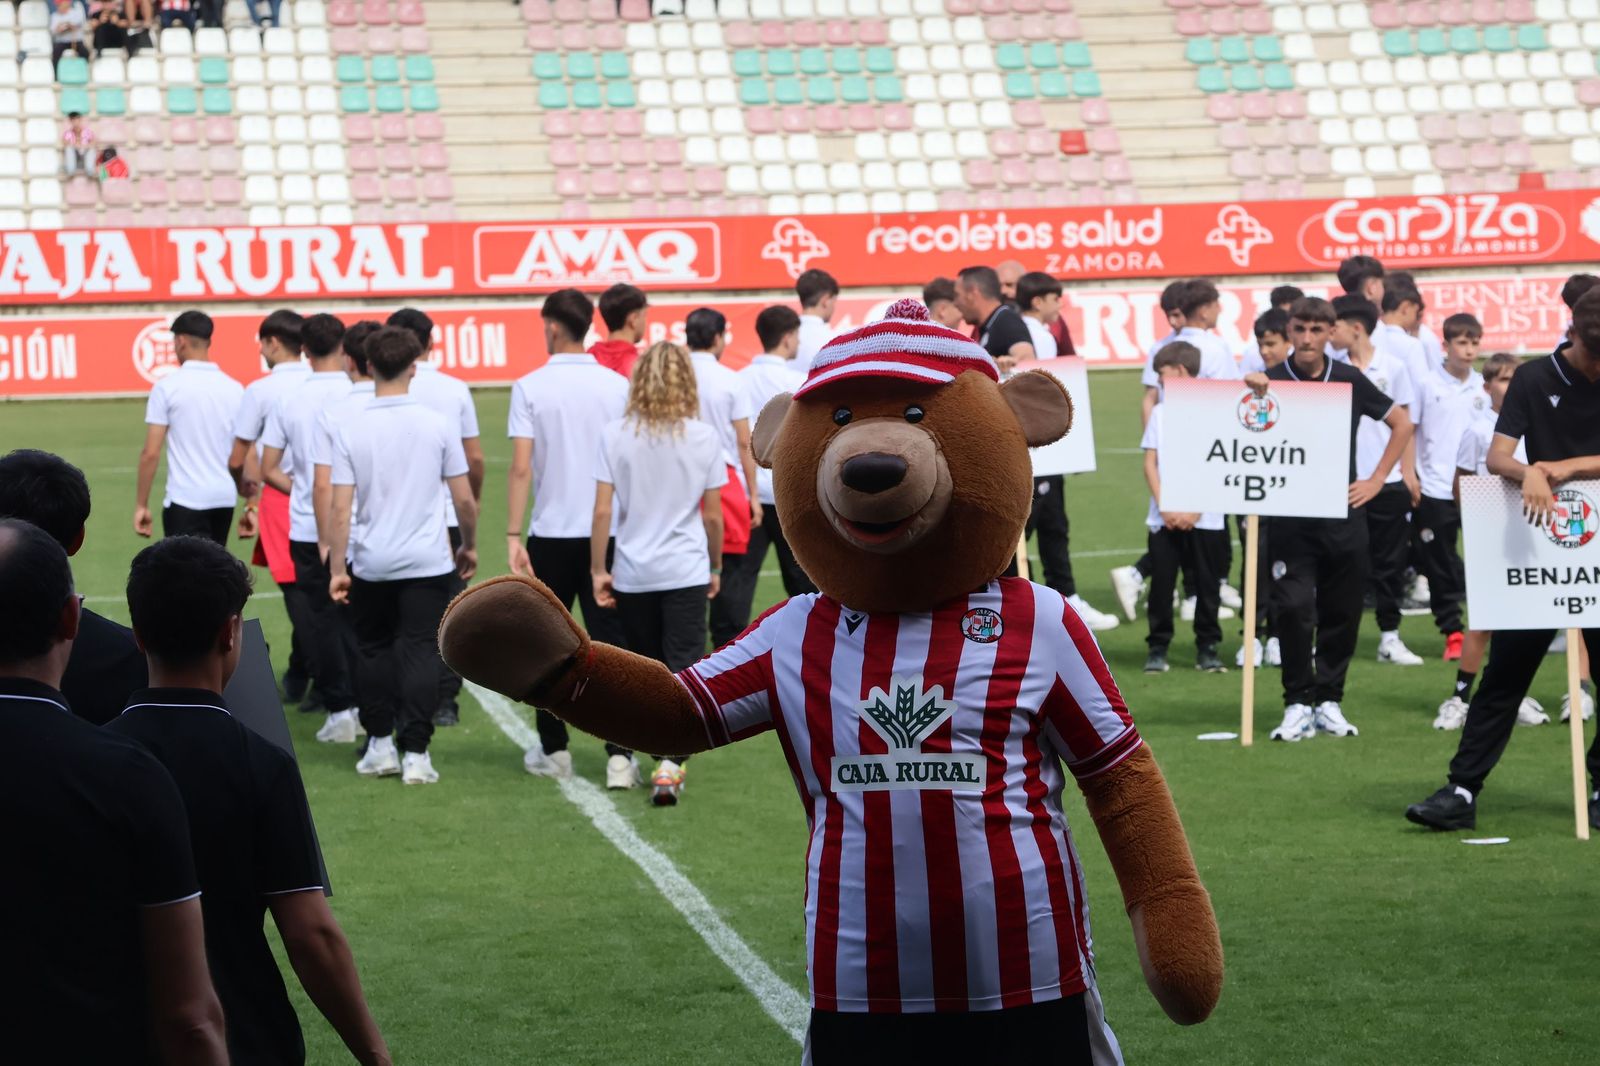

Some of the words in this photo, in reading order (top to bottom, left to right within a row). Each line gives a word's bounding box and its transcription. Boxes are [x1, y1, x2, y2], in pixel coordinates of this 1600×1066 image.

[866, 212, 1053, 254] recoletas
[1061, 207, 1163, 248] salud
[0, 230, 152, 300] AJA
[168, 224, 455, 296] RURAL
[488, 228, 699, 283] AMAQ
[1044, 250, 1165, 274] ZAMORA
[1323, 242, 1432, 259] EMBUTIDOS
[1452, 238, 1540, 255] JAMONES
[1206, 438, 1306, 465] Alevín
[837, 762, 890, 785] CAJA
[895, 761, 980, 783] RURAL
